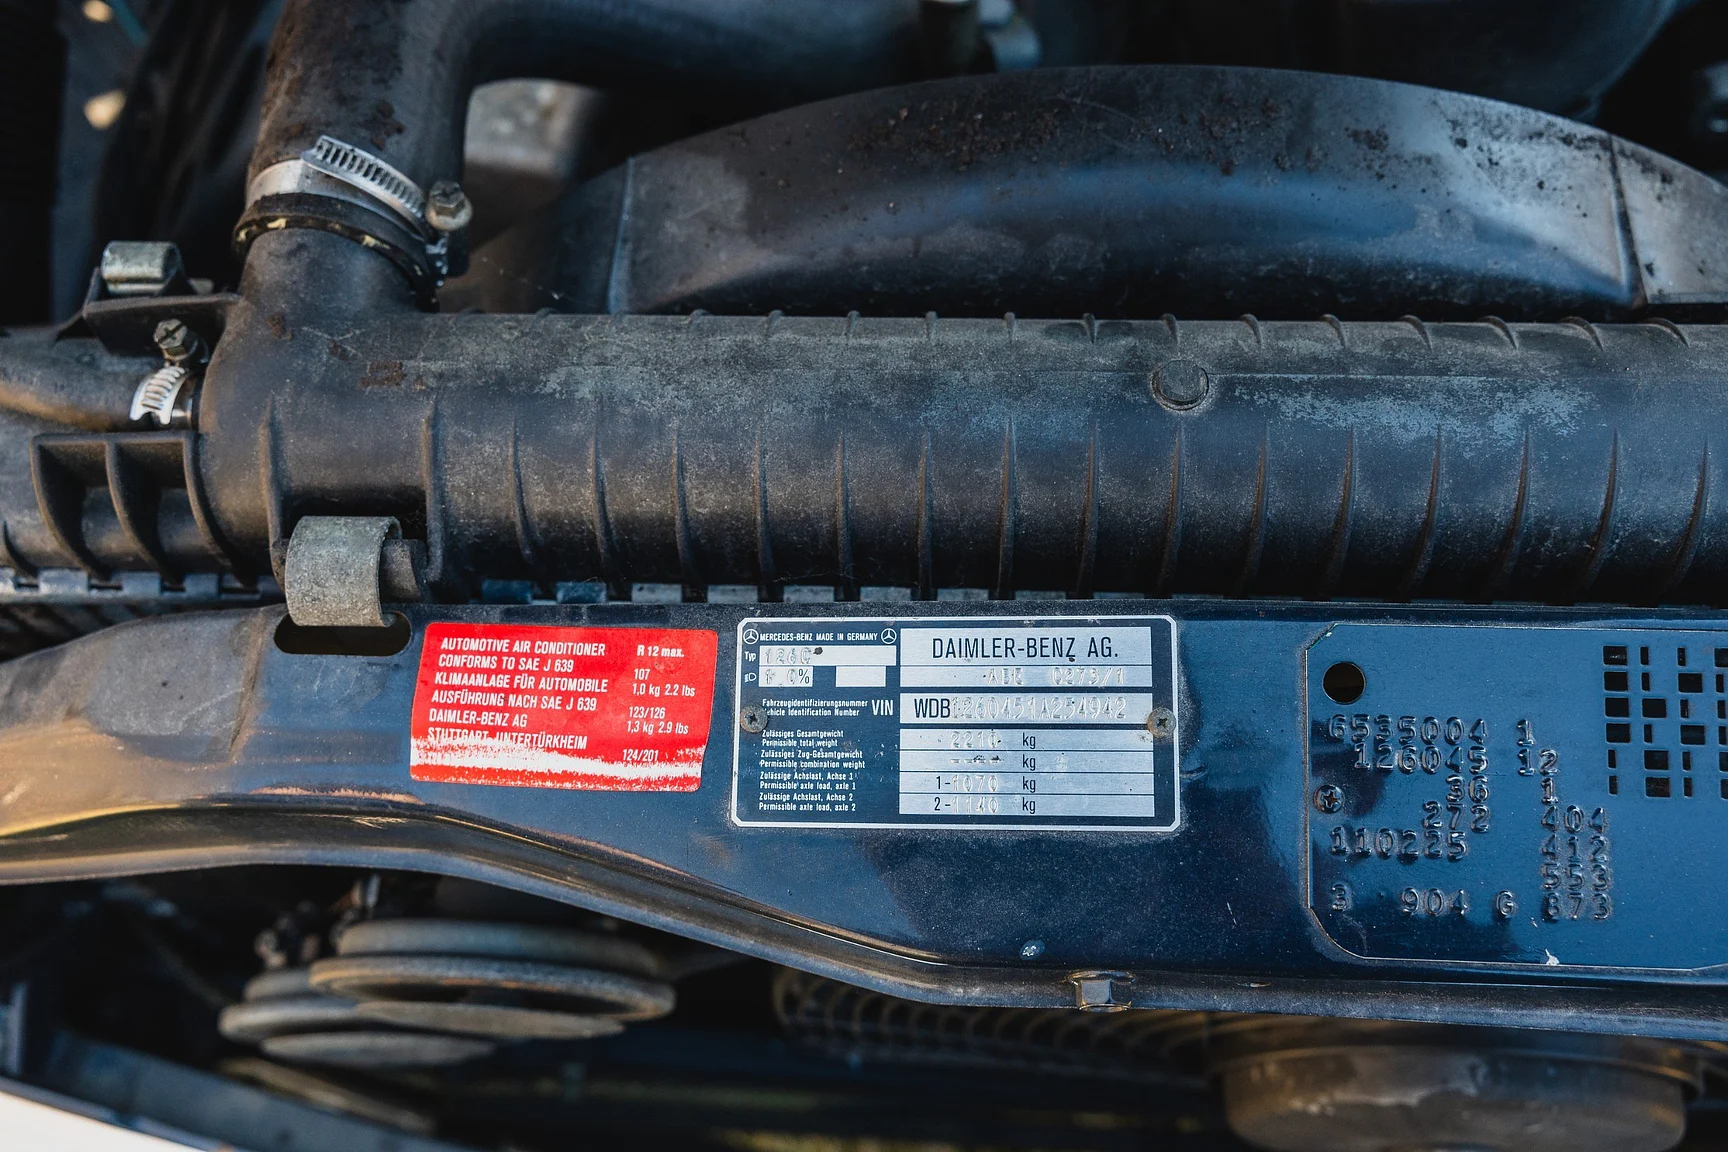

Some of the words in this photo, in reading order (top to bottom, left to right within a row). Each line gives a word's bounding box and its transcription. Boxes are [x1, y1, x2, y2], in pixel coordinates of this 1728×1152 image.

[760, 632, 812, 641] MERCEDES-BENZ
[816, 633, 834, 641] MADE
[837, 633, 843, 641] IN
[847, 632, 878, 641] GERMANY
[441, 638, 509, 652] AUTOMOTIVE
[512, 640, 530, 654] AIR
[534, 641, 605, 656] CONDITIONER
[637, 645, 644, 656] R
[647, 646, 659, 657] 12
[661, 646, 684, 658] max.
[932, 637, 1076, 659] DAIMLER-BENZ
[1087, 636, 1119, 658] AG.
[438, 654, 498, 669] CONFORMS
[501, 657, 514, 670] TO
[518, 657, 539, 671] SAE
[543, 659, 551, 671] J
[554, 659, 574, 673] 639
[745, 652, 756, 661] Typ
[634, 668, 650, 680] 107
[434, 673, 510, 688] KLIMAANLAGE
[513, 673, 535, 689] FÜR
[538, 677, 608, 693] AUTOMOBILE
[632, 683, 646, 696] 1,0
[649, 684, 661, 697] kg
[665, 684, 679, 696] 2.2
[681, 684, 695, 697] lbs
[431, 689, 504, 706] AUSFÜHRUNG
[507, 693, 538, 708] NACH
[541, 696, 562, 710] SAE
[565, 697, 573, 710] J
[577, 698, 597, 711] 639
[762, 698, 868, 708] Fahrzeugidentifizierungsnummer
[872, 699, 894, 716] VIN
[429, 708, 510, 726] DAIMLER-BENZ
[512, 713, 527, 727] AG
[628, 706, 666, 718] 123/126
[788, 708, 833, 716] Identification
[835, 708, 859, 716] Number
[627, 720, 640, 733] 1,3
[642, 721, 654, 734] kg
[658, 721, 673, 733] 2.9
[675, 721, 689, 734] lbs
[762, 730, 794, 738] Zulässiges
[796, 730, 843, 739] Gesamtgewicht
[1328, 714, 1488, 745] 6535004
[1517, 719, 1535, 747] 1
[762, 739, 797, 747] Permissible
[817, 739, 838, 748] weight
[1022, 732, 1036, 749] kg
[622, 749, 658, 762] 124/201
[760, 750, 794, 758] Zulässiges
[797, 750, 863, 759] Zug-Gesamtgewicht
[1022, 754, 1036, 770] kg
[1354, 743, 1489, 774] 126045
[1517, 748, 1559, 776] 12
[760, 760, 797, 768] Permissible
[800, 760, 840, 768] combination
[843, 760, 865, 769] weight
[760, 772, 791, 780] Zulässige
[827, 772, 846, 780] Achse
[849, 772, 853, 780] 1
[760, 782, 797, 790] Permissible
[835, 782, 849, 790] axle
[1022, 776, 1036, 792] kg
[1445, 774, 1490, 803] 36
[1541, 777, 1558, 804] 1
[759, 792, 791, 801] Zulässige
[826, 793, 846, 801] Achse
[759, 803, 796, 811] Permissible
[799, 803, 813, 811] axle
[835, 803, 849, 811] axle
[1022, 798, 1036, 814] kg
[1421, 801, 1490, 832] 272
[1540, 805, 1608, 834] 404
[1330, 826, 1467, 861] 110225
[1541, 834, 1608, 863] 412
[1541, 862, 1611, 892] 553
[1400, 887, 1468, 917] 904
